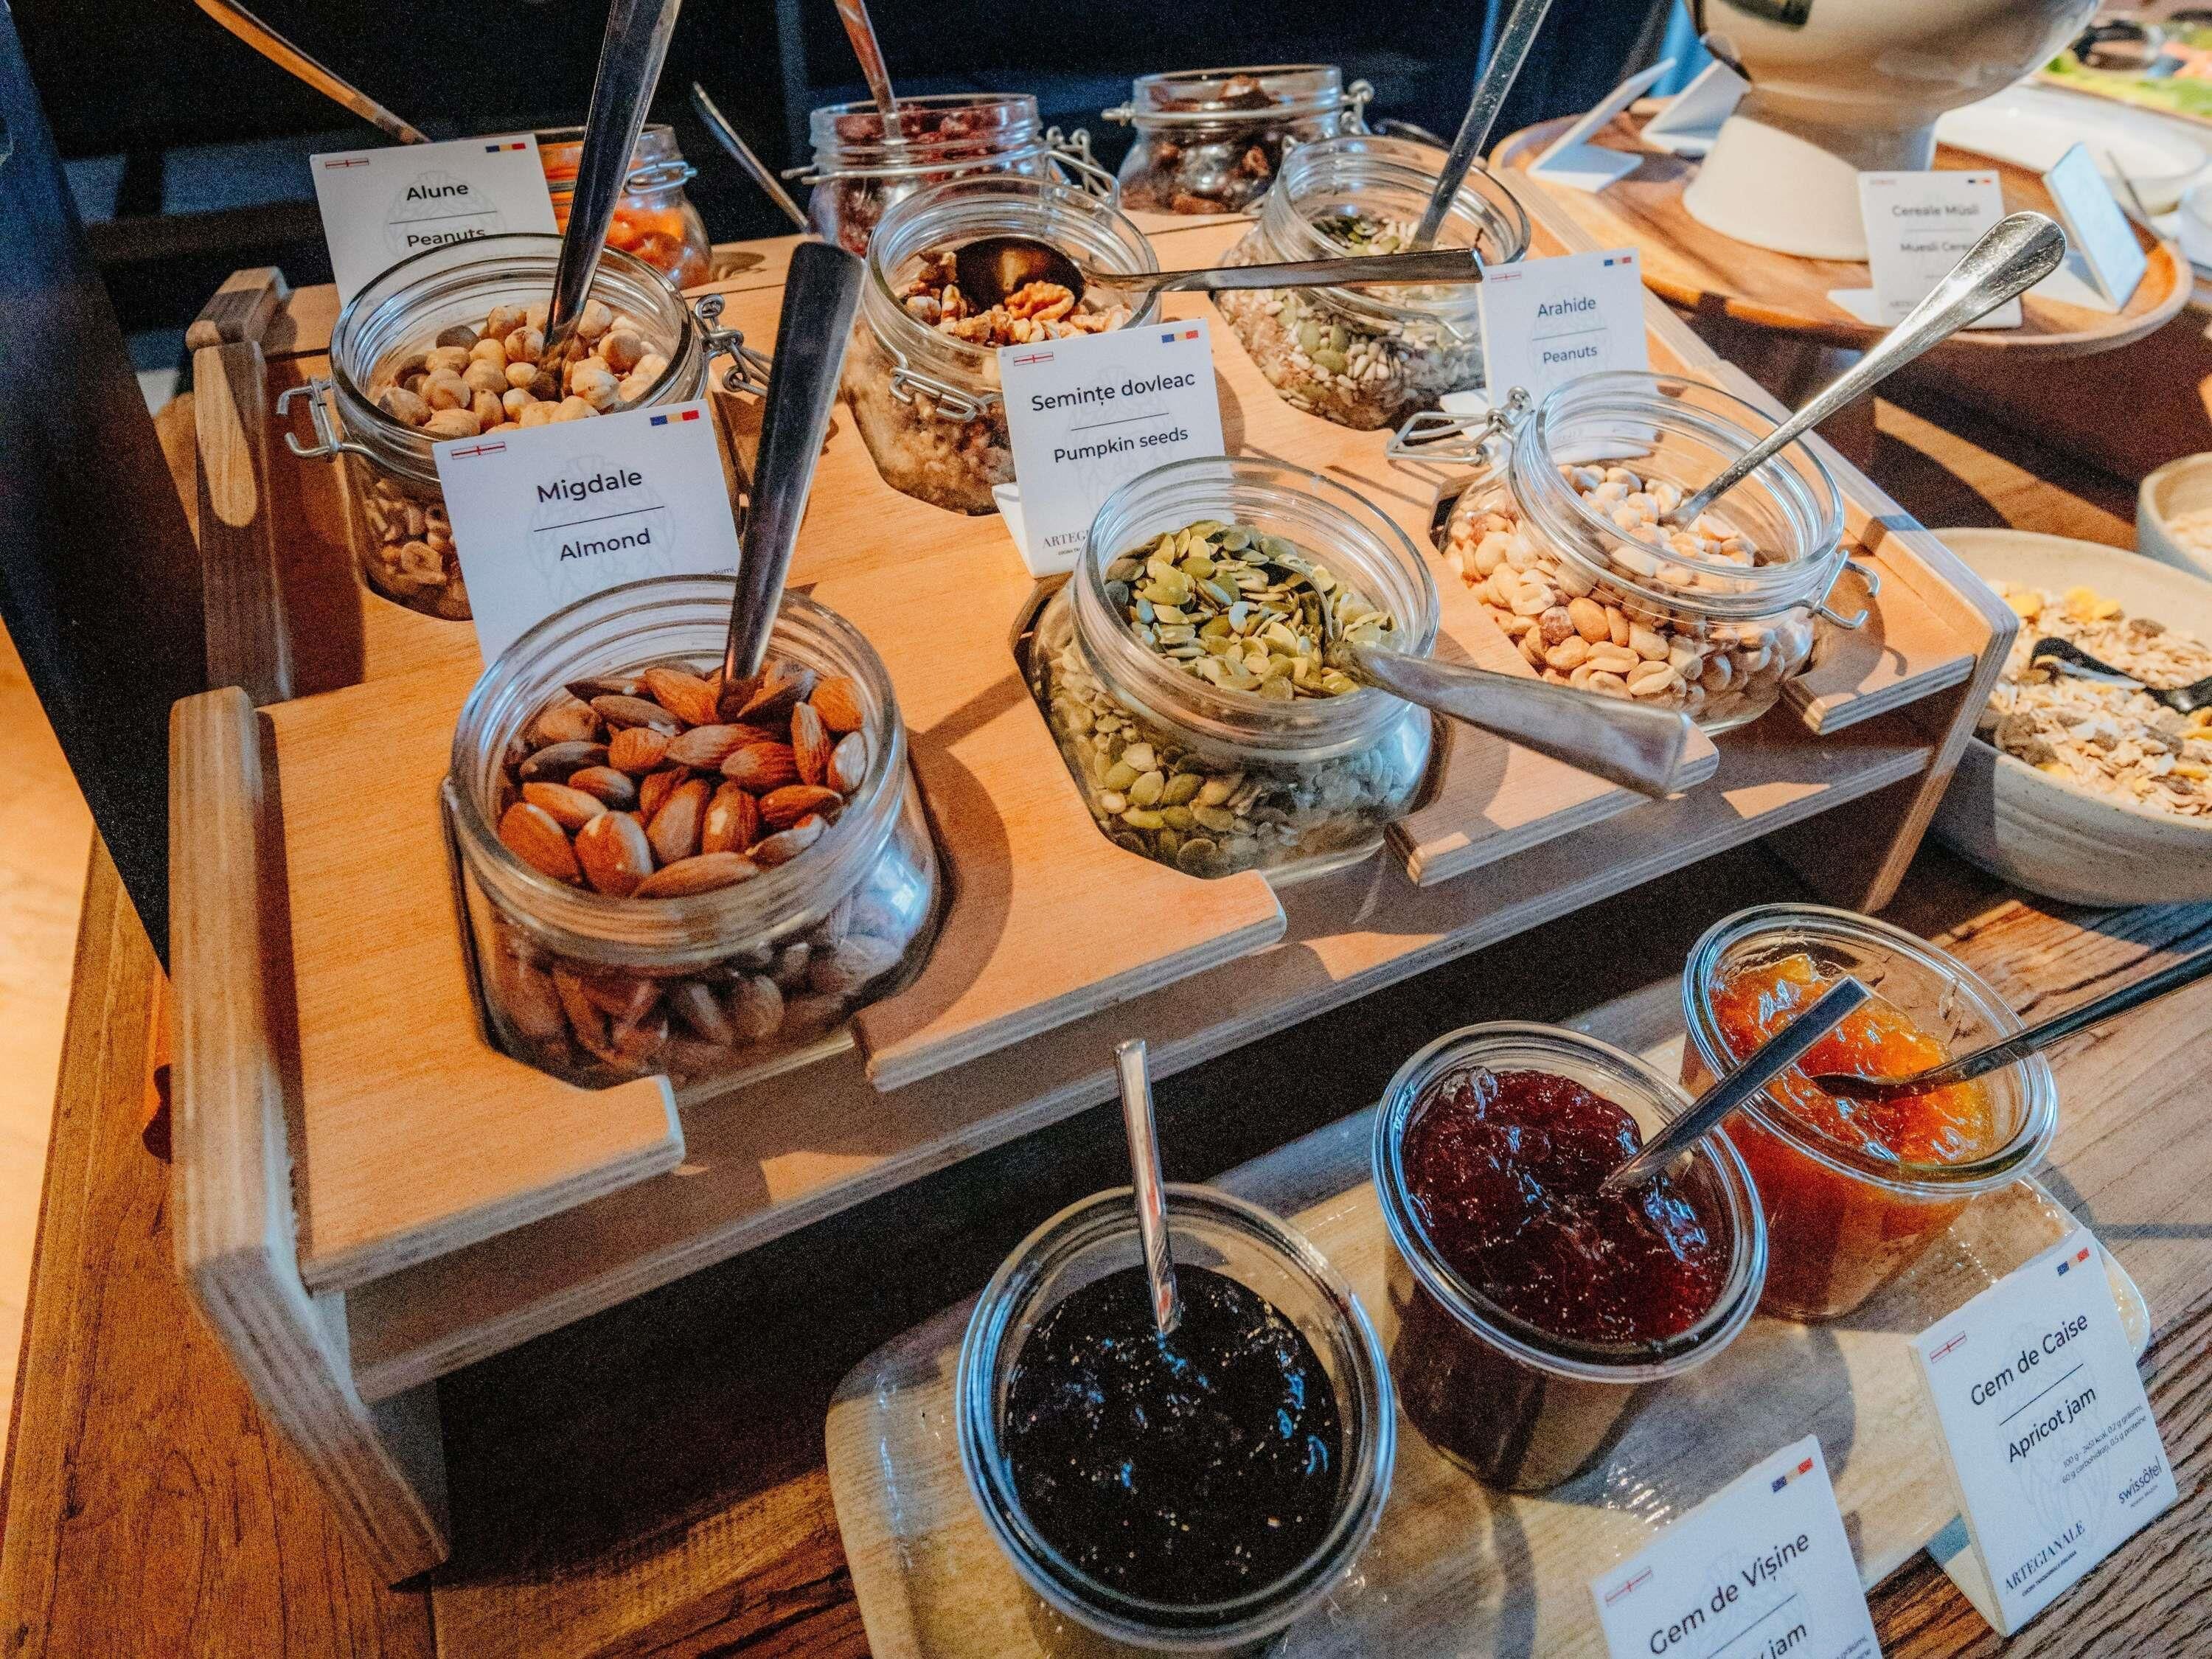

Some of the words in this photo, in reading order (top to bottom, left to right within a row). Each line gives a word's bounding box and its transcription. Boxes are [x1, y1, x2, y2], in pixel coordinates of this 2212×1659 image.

[406, 183, 469, 201] Alune
[1892, 204, 1941, 218] Cereale
[406, 228, 485, 247] Peanuts
[1537, 296, 1597, 318] Arahide
[1543, 345, 1598, 364] Peanuts
[1031, 384, 1116, 411] Semințe
[1121, 372, 1196, 397] dovleac
[1054, 437, 1135, 464] Pumpkin
[1140, 427, 1189, 448] seeds
[537, 468, 643, 504] Migdale
[560, 527, 651, 562] Almond
[1971, 1368, 2014, 1406] Gem
[2017, 1350, 2039, 1374] de
[2042, 1315, 2088, 1354] Caise
[2008, 1409, 2065, 1463] Apricot
[2065, 1388, 2097, 1424] jam
[2118, 1455, 2163, 1504] swissôtel
[2005, 1520, 2086, 1594] ARTEGIANALE
[1649, 1607, 1706, 1655] Gem
[1711, 1585, 1739, 1614] de
[1741, 1533, 1810, 1588] Vișine
